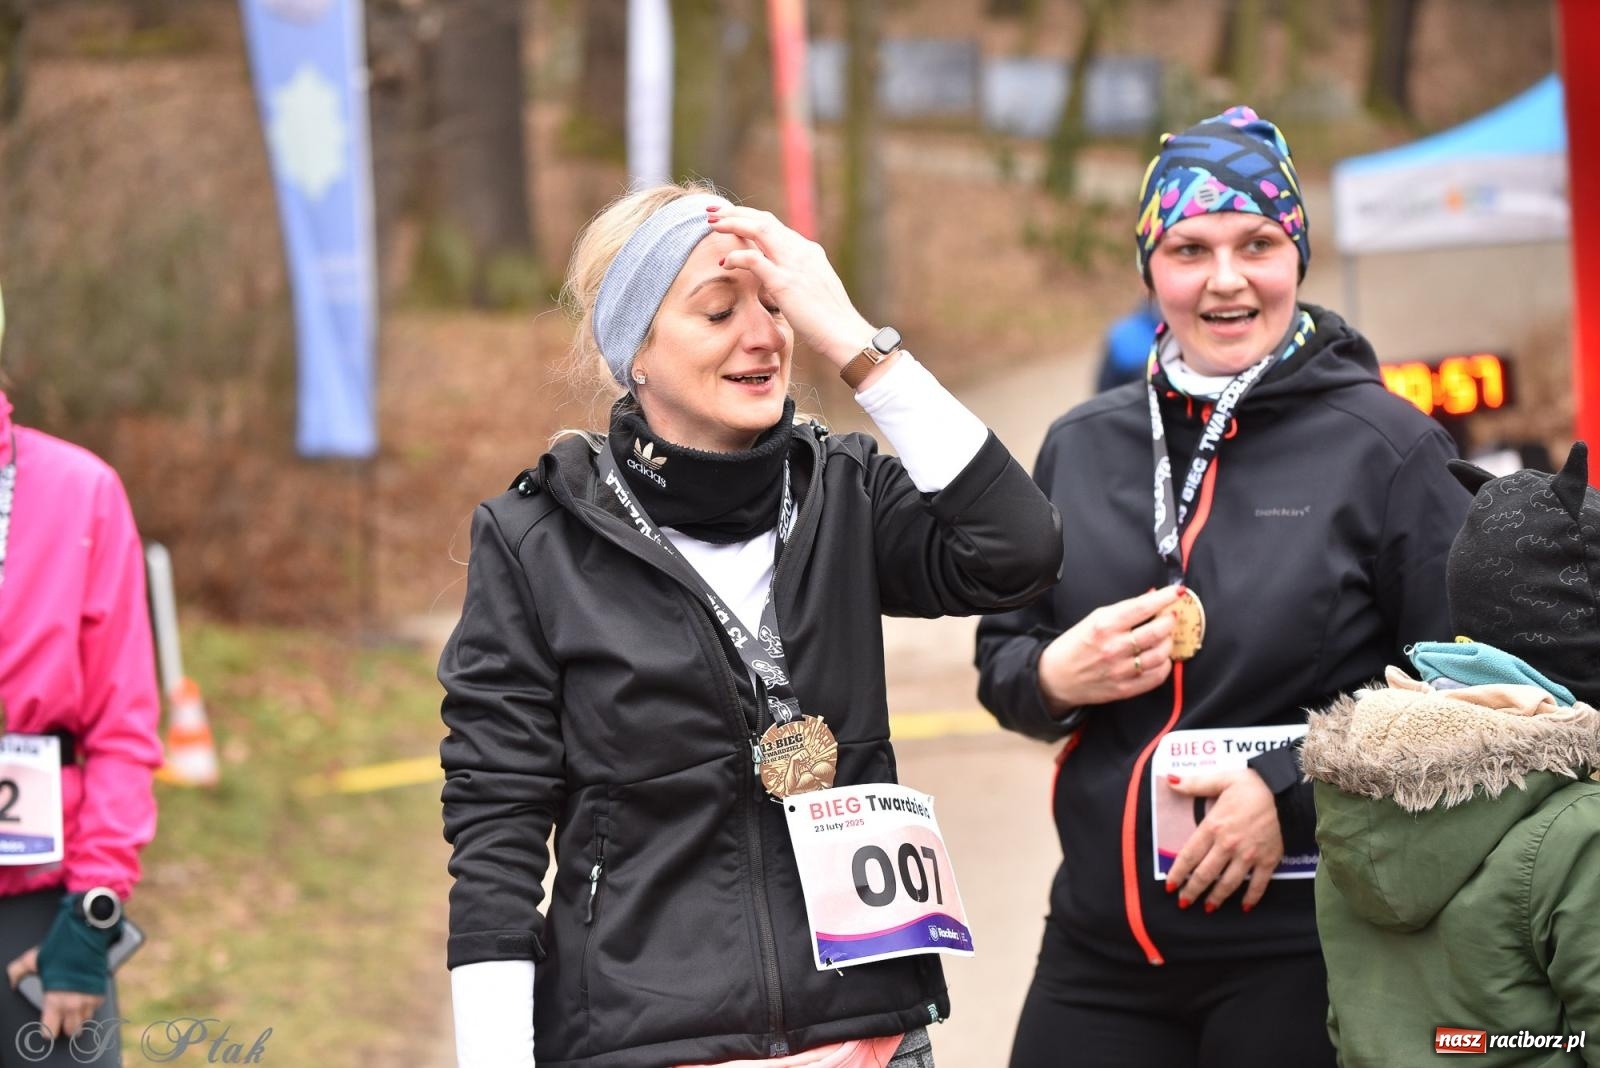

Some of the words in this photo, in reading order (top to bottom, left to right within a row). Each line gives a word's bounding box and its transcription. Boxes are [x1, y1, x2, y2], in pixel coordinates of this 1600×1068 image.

[627, 458, 666, 488] adidas
[776, 733, 803, 748] BIEG
[1170, 740, 1216, 756] BIEG
[1223, 737, 1291, 753] Tward
[810, 797, 861, 820] BIEG
[814, 824, 825, 833] 23
[826, 822, 844, 832] luty
[845, 819, 865, 828] 2025
[851, 842, 944, 907] 007
